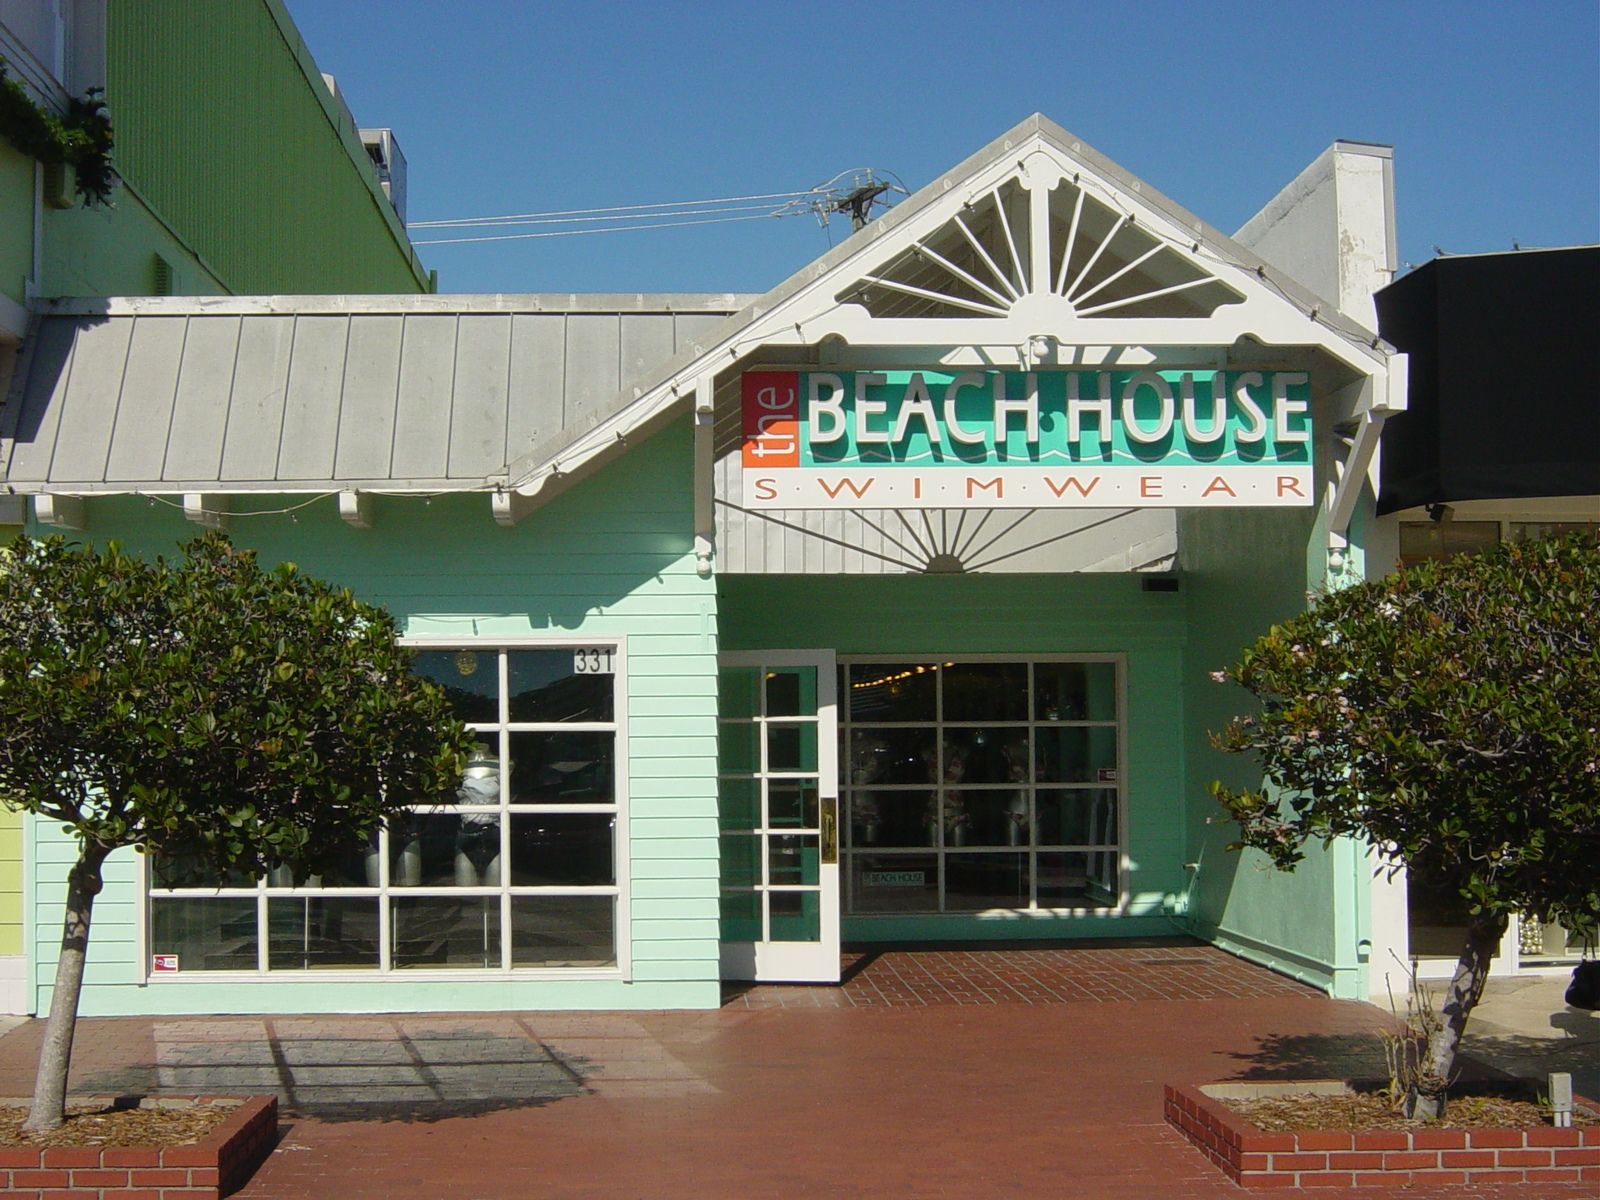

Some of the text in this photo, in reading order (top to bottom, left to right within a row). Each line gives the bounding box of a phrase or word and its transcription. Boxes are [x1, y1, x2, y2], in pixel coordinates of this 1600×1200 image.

[746, 386, 796, 458] the
[807, 372, 1310, 444] BEACH HOUSE
[575, 648, 611, 672] 331
